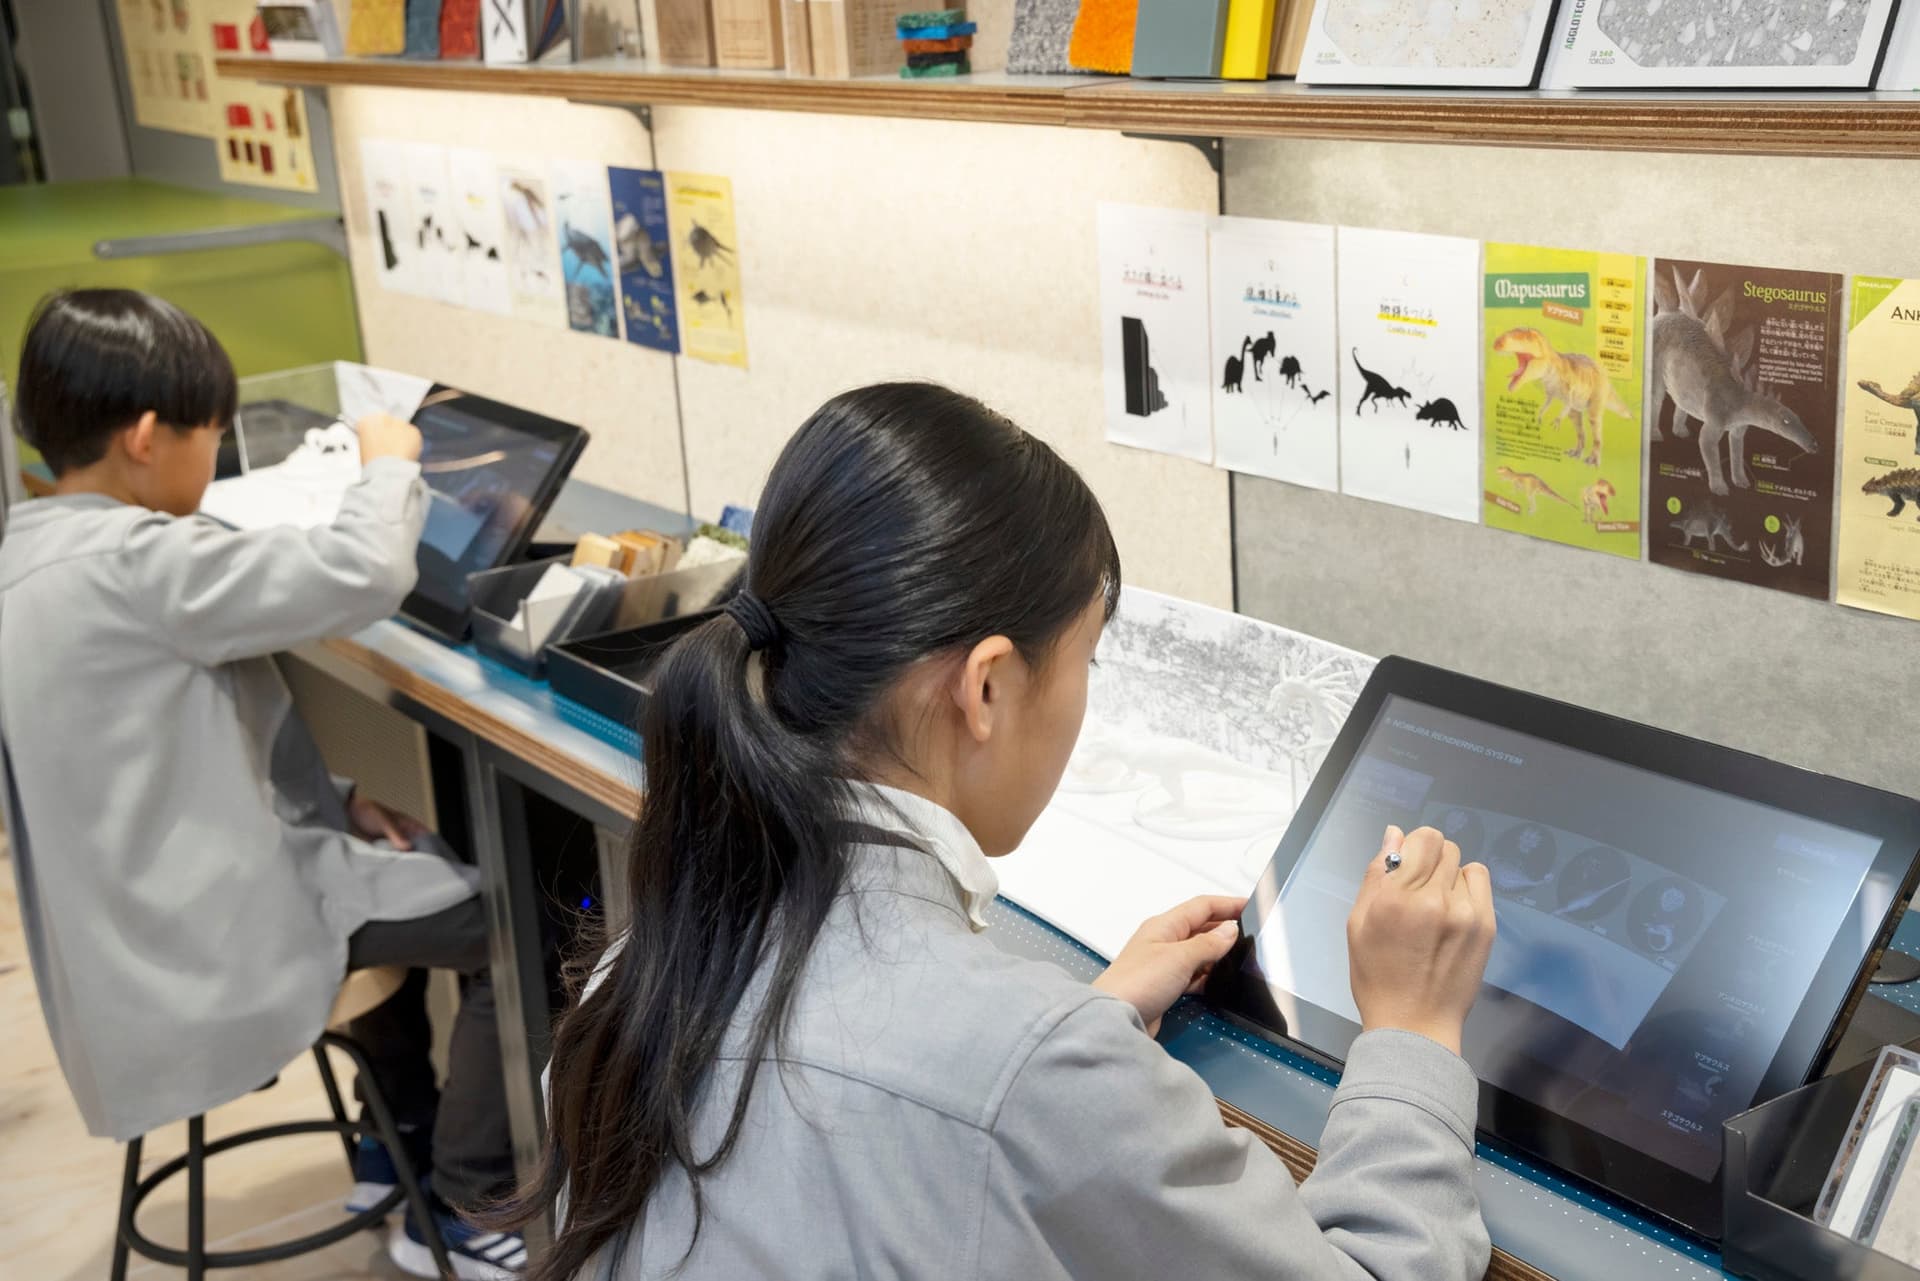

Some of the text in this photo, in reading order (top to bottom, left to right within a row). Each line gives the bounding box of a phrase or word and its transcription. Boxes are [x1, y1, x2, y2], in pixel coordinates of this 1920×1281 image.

[1564, 0, 1588, 50] AGGLOTEC
[1494, 279, 1586, 304] Mapusaurus
[1743, 281, 1827, 304] Stegosaurus
[1430, 731, 1484, 754] RENDERING
[1485, 748, 1524, 766] SYSTEM
[1660, 1109, 1704, 1133] ステゴサウルス
